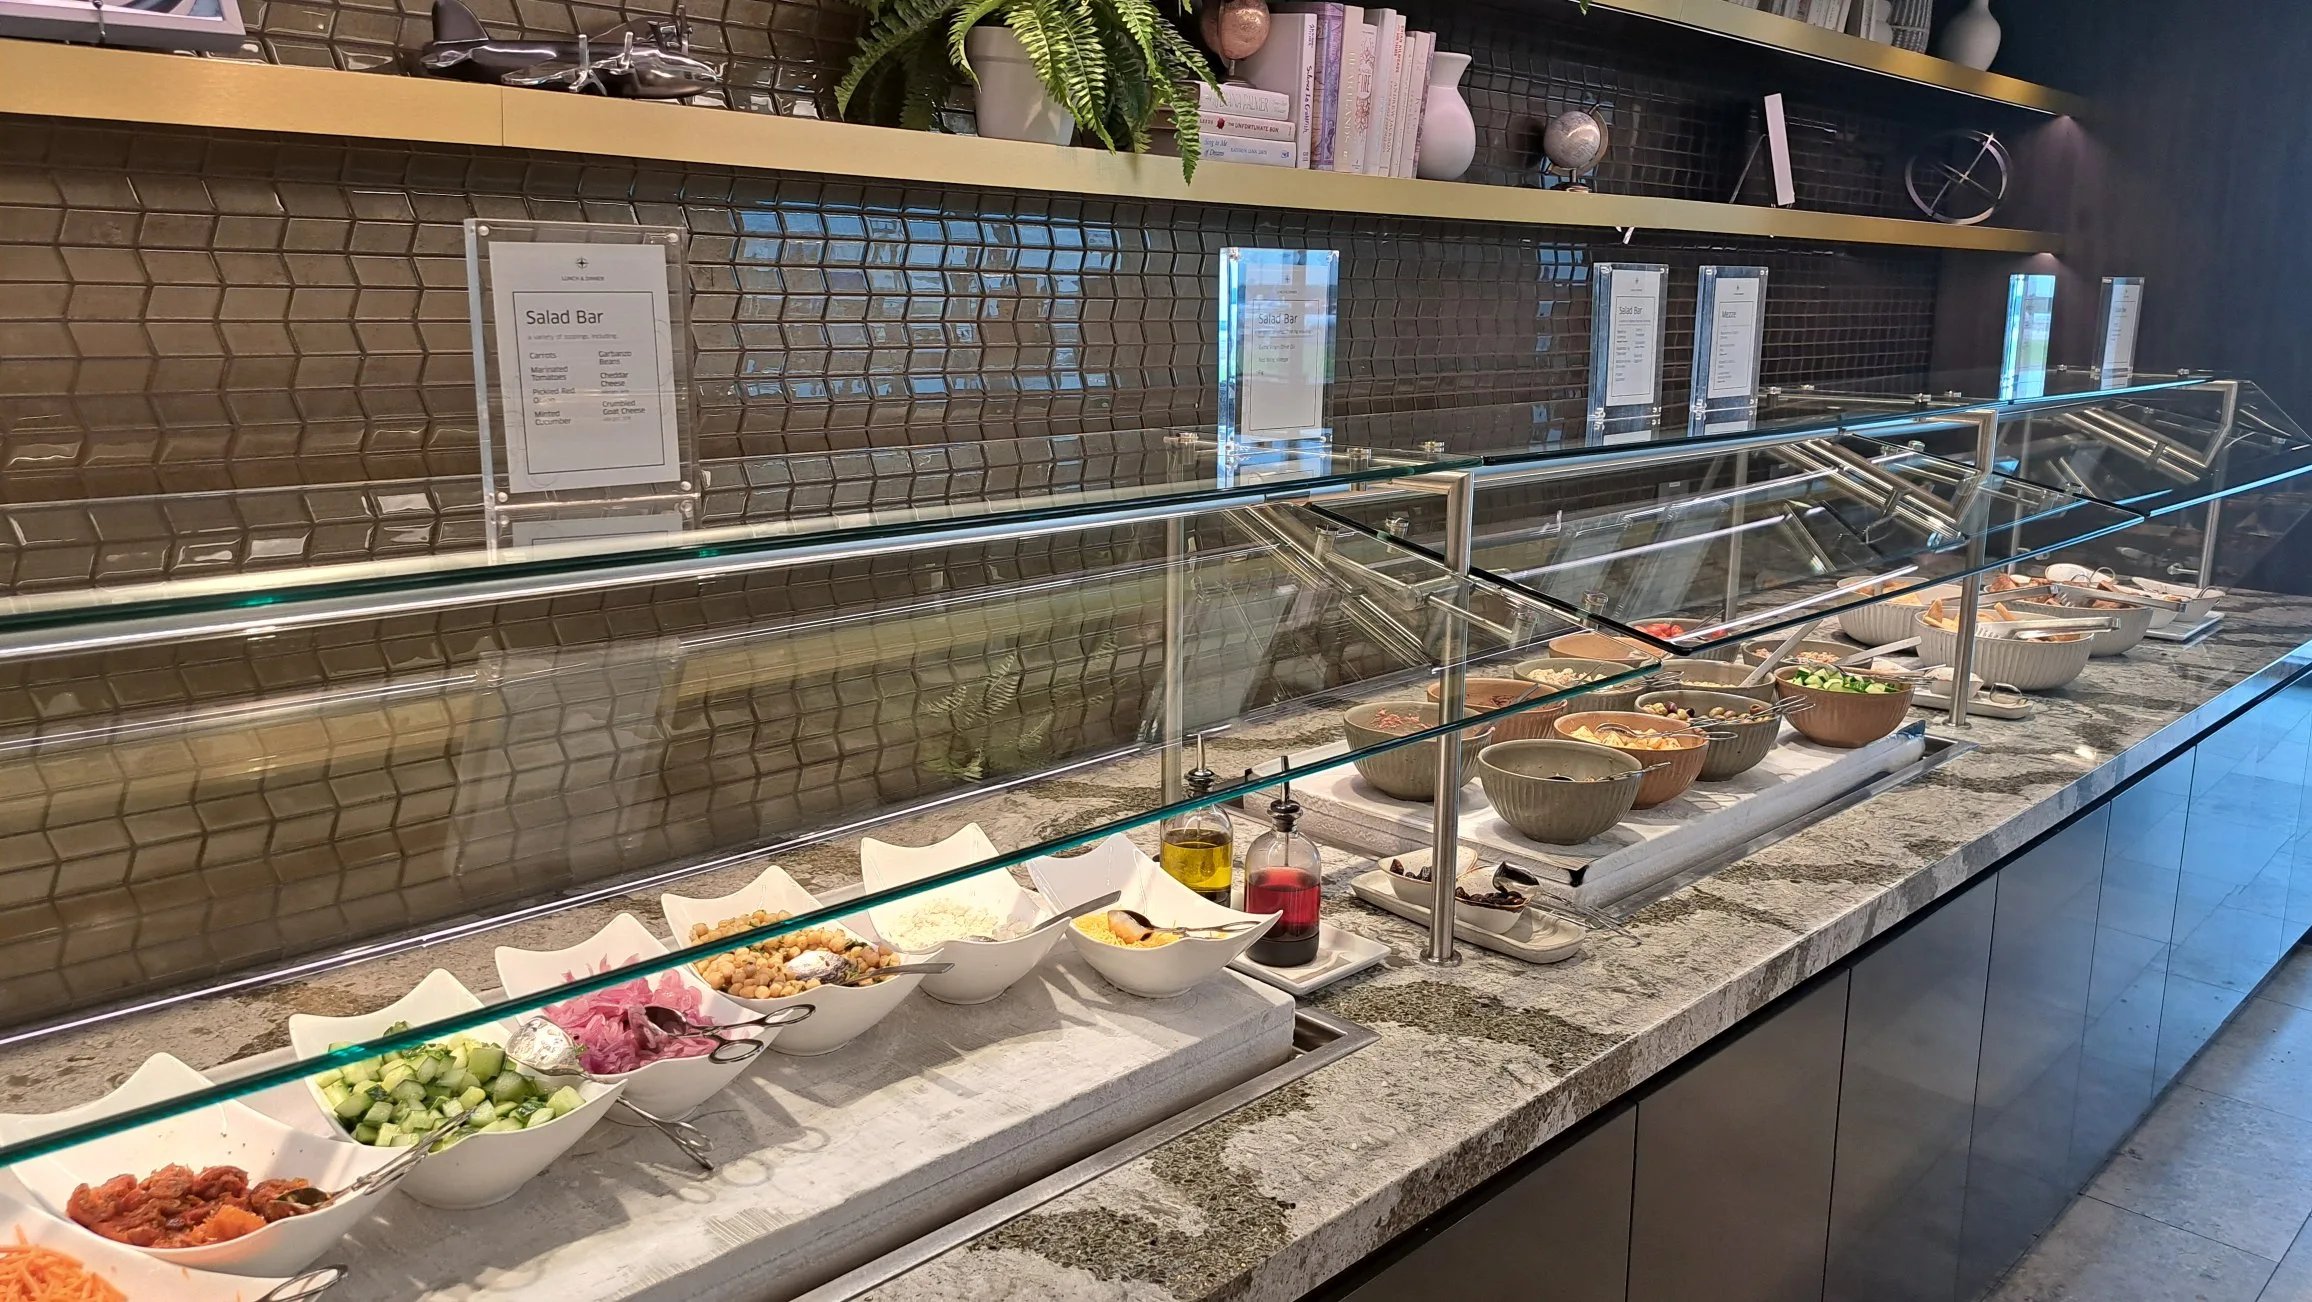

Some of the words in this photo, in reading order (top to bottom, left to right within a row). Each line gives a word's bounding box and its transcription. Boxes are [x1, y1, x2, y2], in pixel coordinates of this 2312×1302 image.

[1344, 51, 1356, 143] HEARTLANDS
[1235, 122, 1269, 133] UNFORTUNATE
[1619, 306, 1633, 315] Salad
[1634, 306, 1643, 314] Bar
[526, 310, 570, 325] Salad
[576, 310, 604, 324] Bar
[1259, 313, 1281, 324] Salad
[1284, 313, 1298, 324] Bar
[598, 350, 632, 358] Garbanzo
[535, 418, 571, 426] Cucumber
